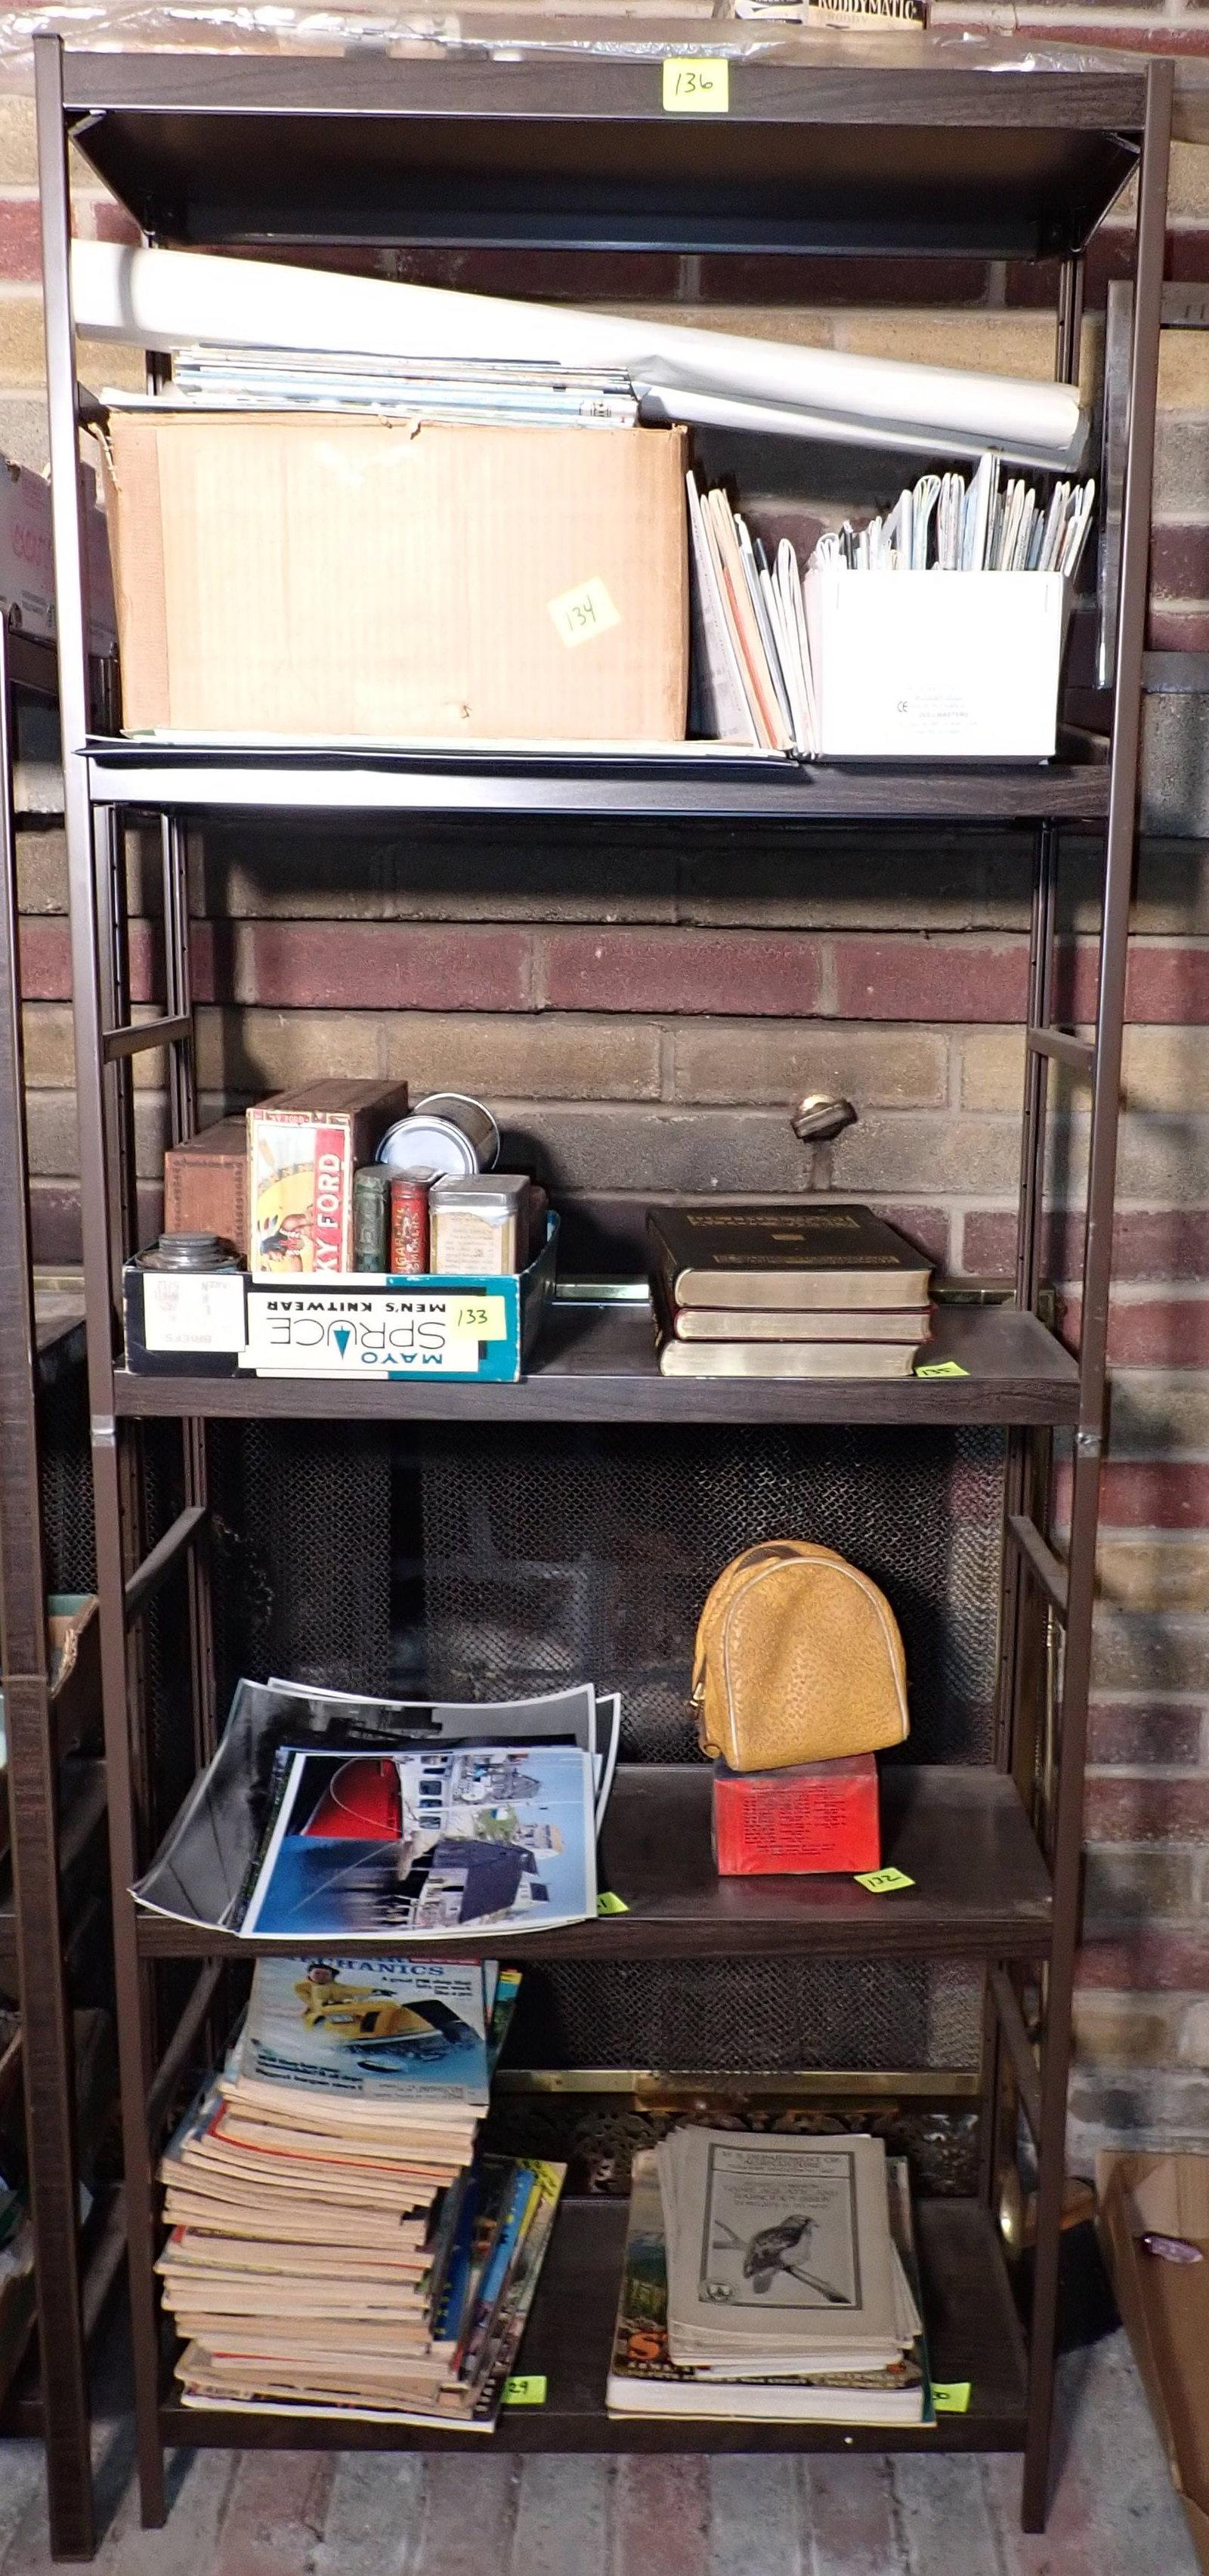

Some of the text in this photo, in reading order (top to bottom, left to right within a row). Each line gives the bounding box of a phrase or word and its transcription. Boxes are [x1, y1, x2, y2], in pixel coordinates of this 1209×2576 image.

[674, 71, 715, 95] 136
[565, 594, 601, 633] 134
[316, 1152, 342, 1231] FORD
[266, 1300, 447, 1314] MEN'S KNITWEAR
[456, 1308, 489, 1328] 133
[266, 1317, 447, 1351] SPRUCE
[360, 1351, 444, 1365] MAYO
[867, 1875, 902, 1888] 132
[508, 2381, 528, 2395] 29
